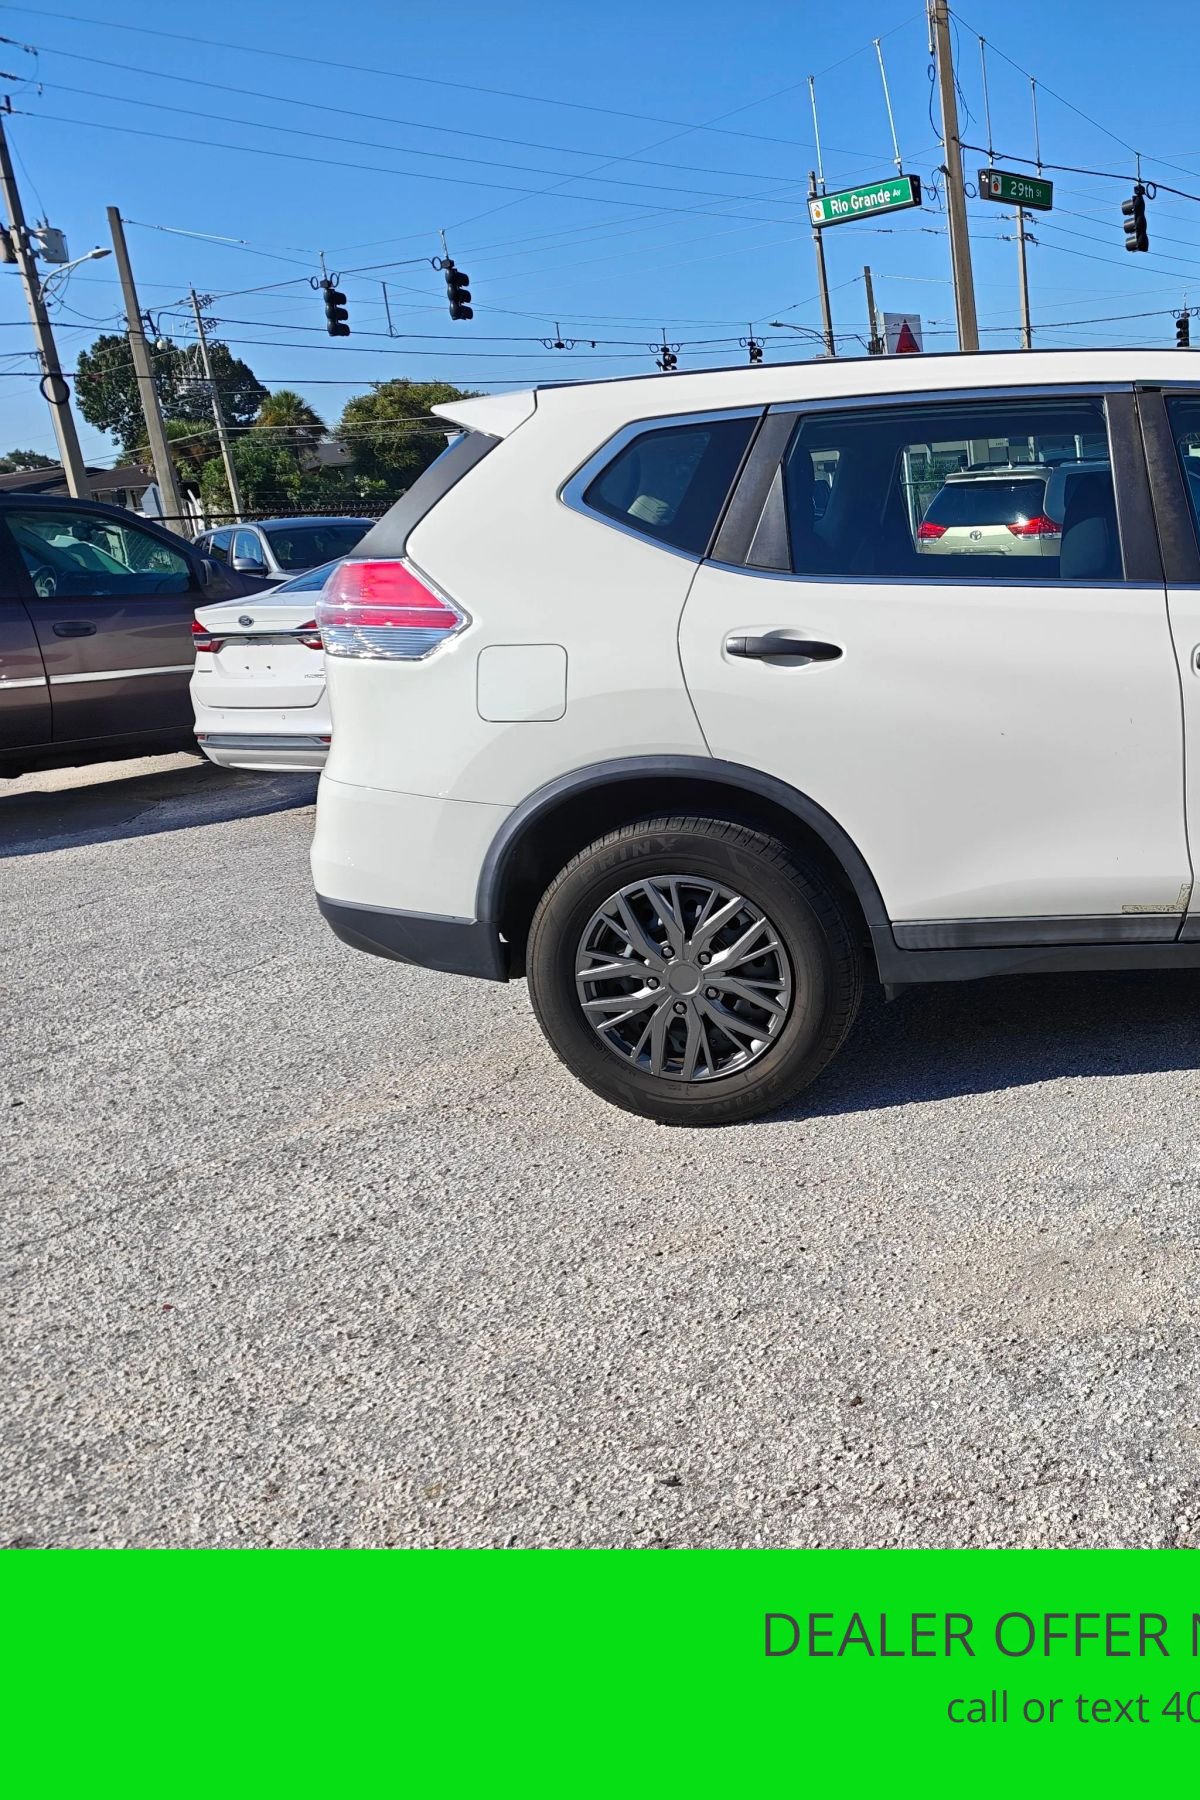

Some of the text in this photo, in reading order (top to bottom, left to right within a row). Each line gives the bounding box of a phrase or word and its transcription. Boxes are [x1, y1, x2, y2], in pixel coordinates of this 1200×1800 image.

[1010, 181, 1034, 199] 29th
[830, 188, 901, 215] Rio Grande Av
